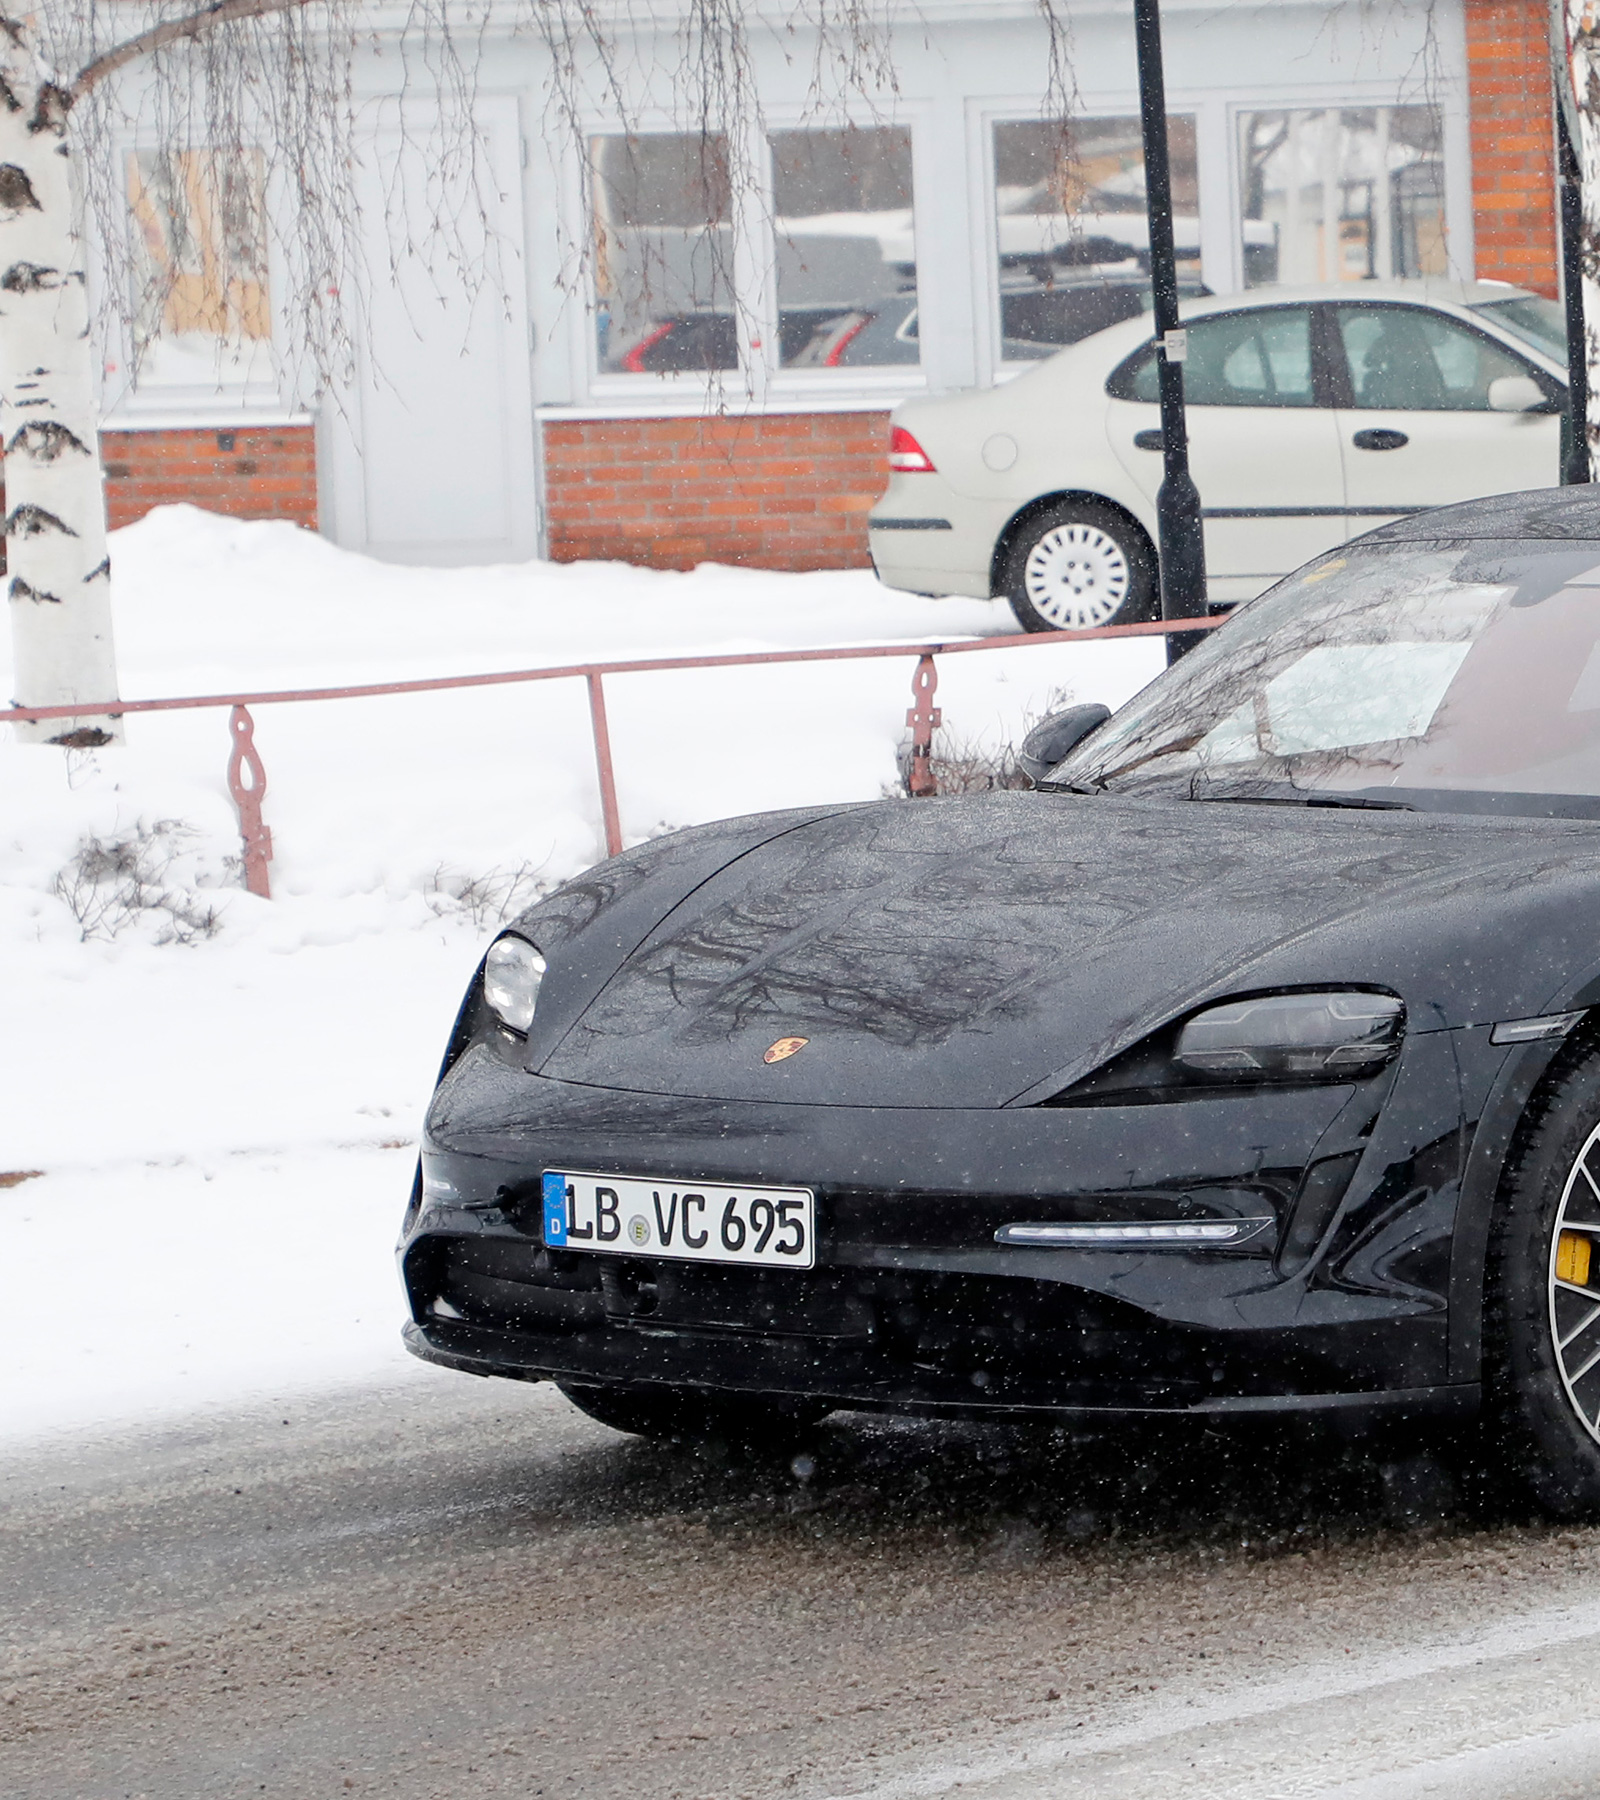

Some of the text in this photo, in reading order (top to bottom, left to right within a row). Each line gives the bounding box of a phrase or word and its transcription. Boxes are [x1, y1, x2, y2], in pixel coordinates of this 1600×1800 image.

[551, 1217, 561, 1235] D
[567, 1184, 805, 1256] LB VC 695
